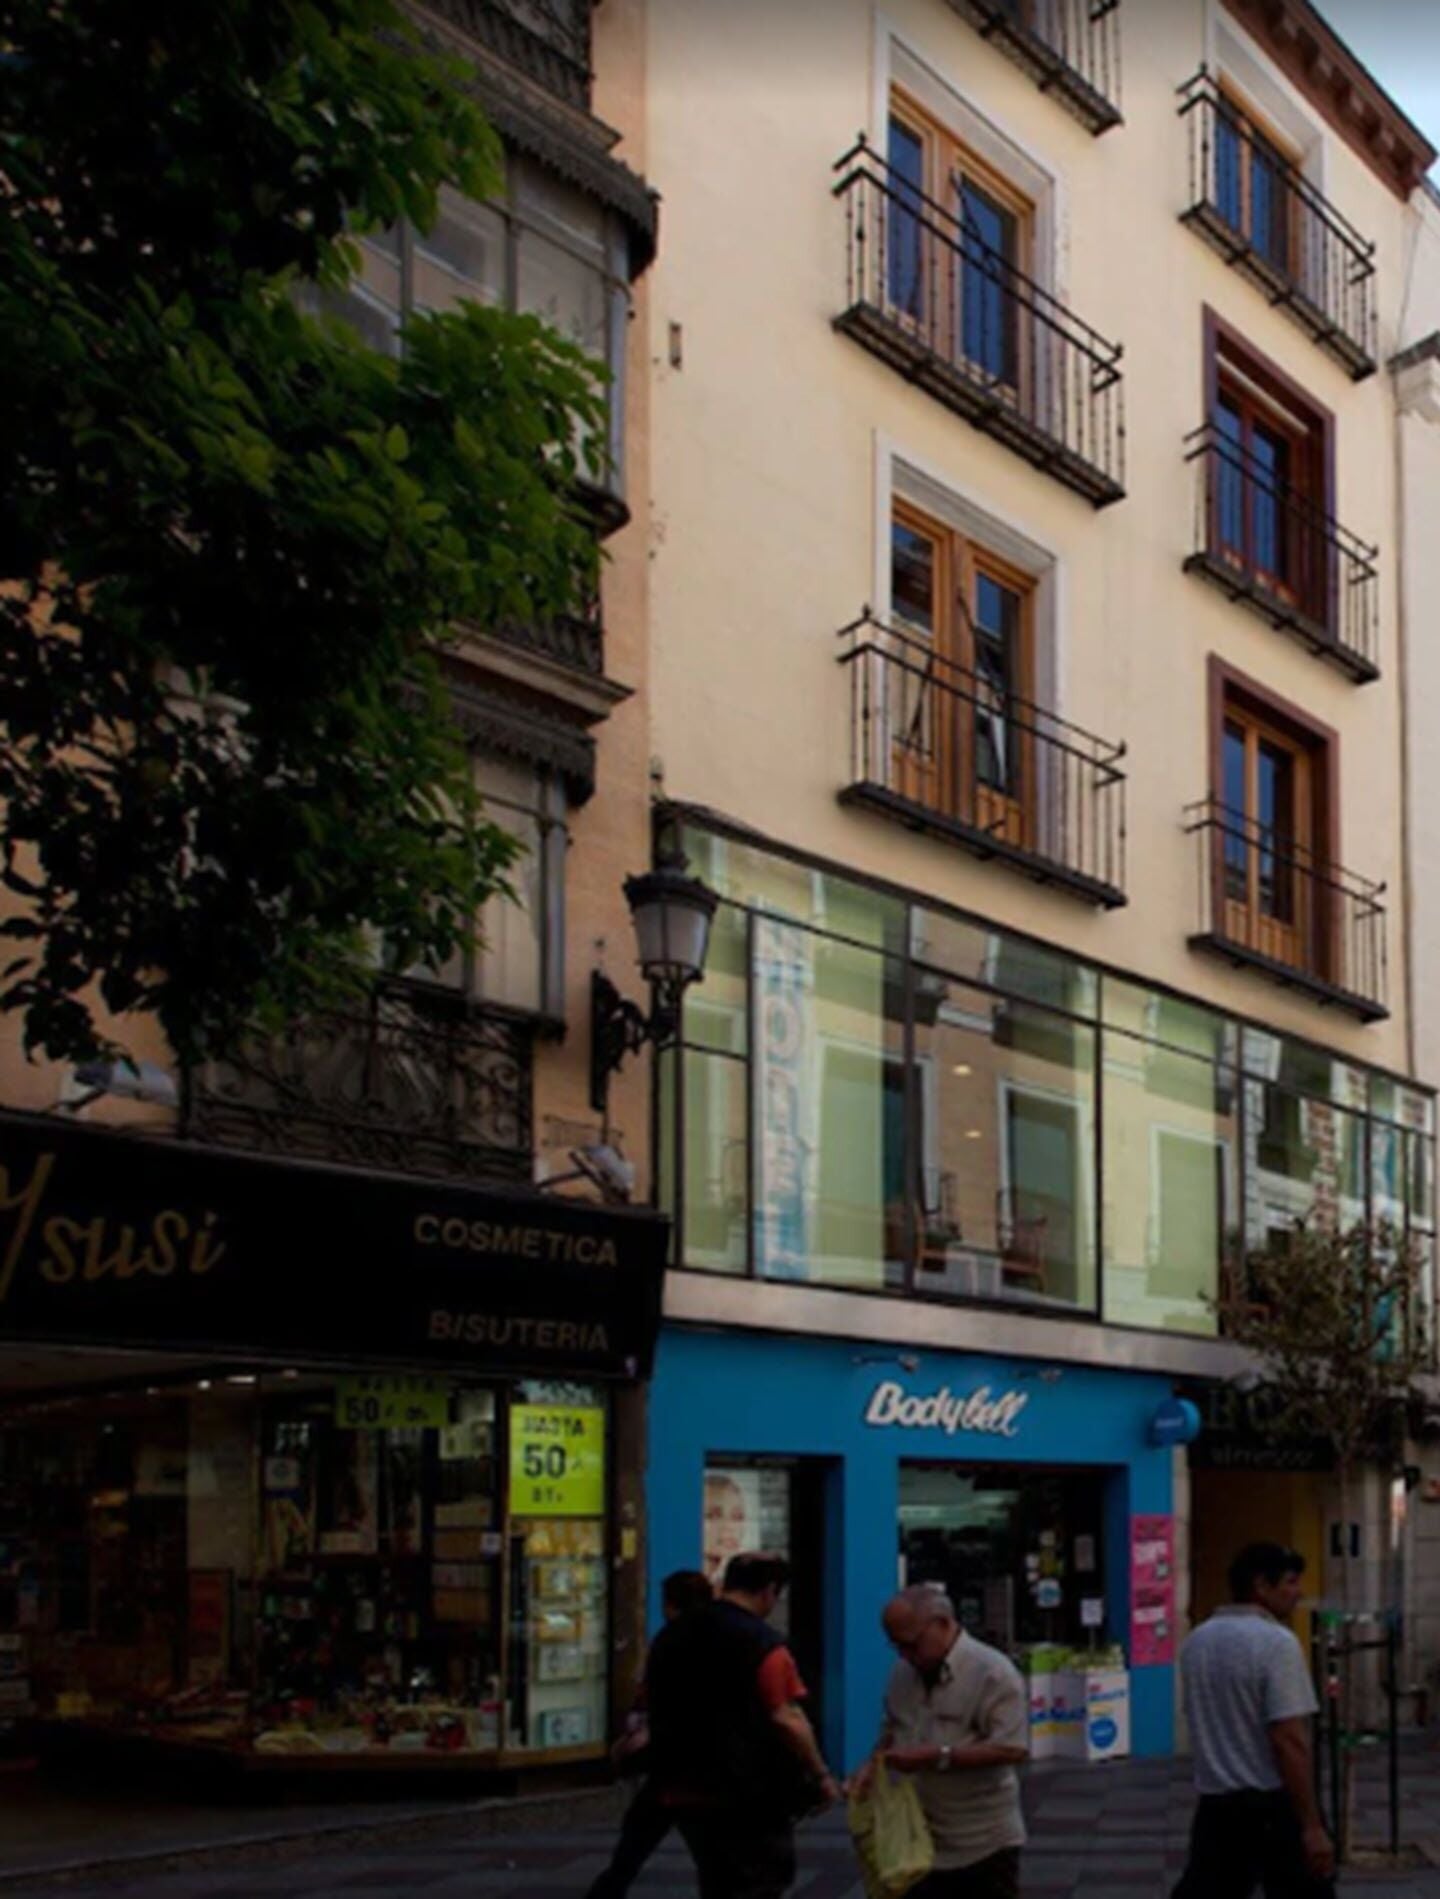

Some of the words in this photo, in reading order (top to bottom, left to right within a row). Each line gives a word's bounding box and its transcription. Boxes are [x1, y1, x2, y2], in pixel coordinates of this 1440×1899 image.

[413, 1213, 618, 1267] COSMETICA
[428, 1309, 609, 1351] BISUTERIA
[866, 1381, 1029, 1438] Bodybell
